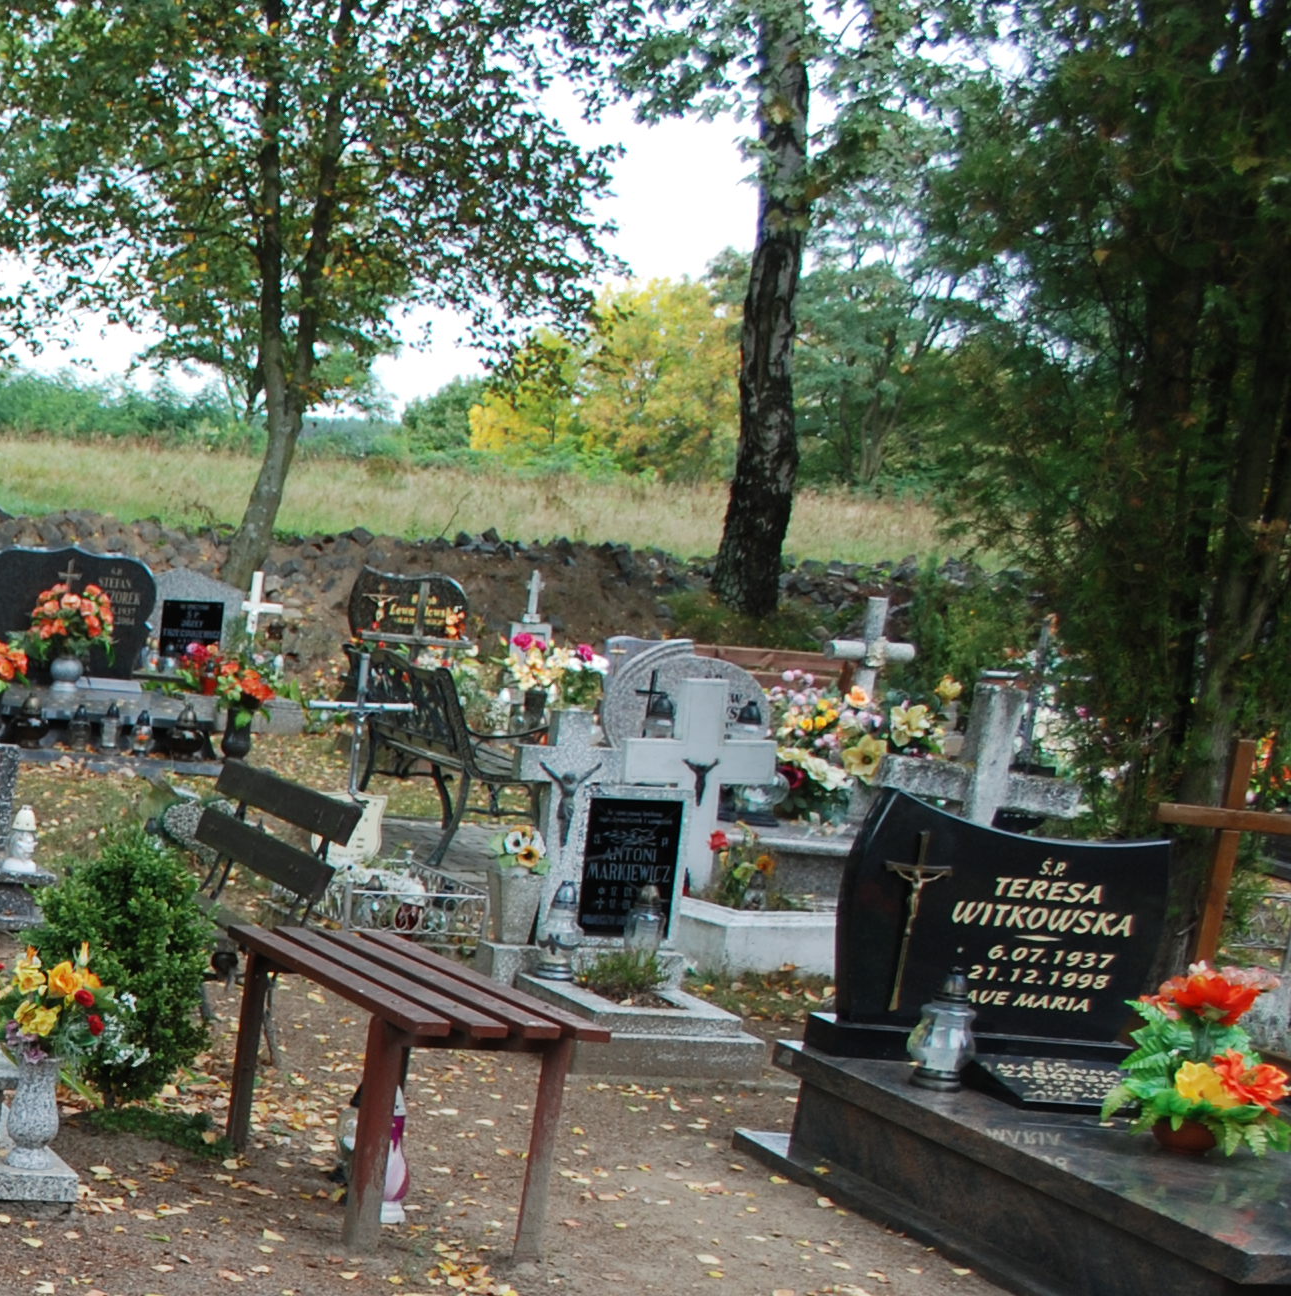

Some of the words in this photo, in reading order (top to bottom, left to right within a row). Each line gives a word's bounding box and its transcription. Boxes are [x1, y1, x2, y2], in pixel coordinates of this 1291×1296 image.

[604, 848, 657, 863] ANTONI
[586, 862, 671, 882] MARKIEWICZ
[994, 876, 1105, 905] TERESA
[951, 900, 1136, 938] WITKOWSKA
[987, 944, 1118, 970] 6.07.1937
[967, 964, 1113, 991] 21.12.1998
[967, 989, 1012, 1006] AVE
[1012, 992, 1092, 1013] MARIA
